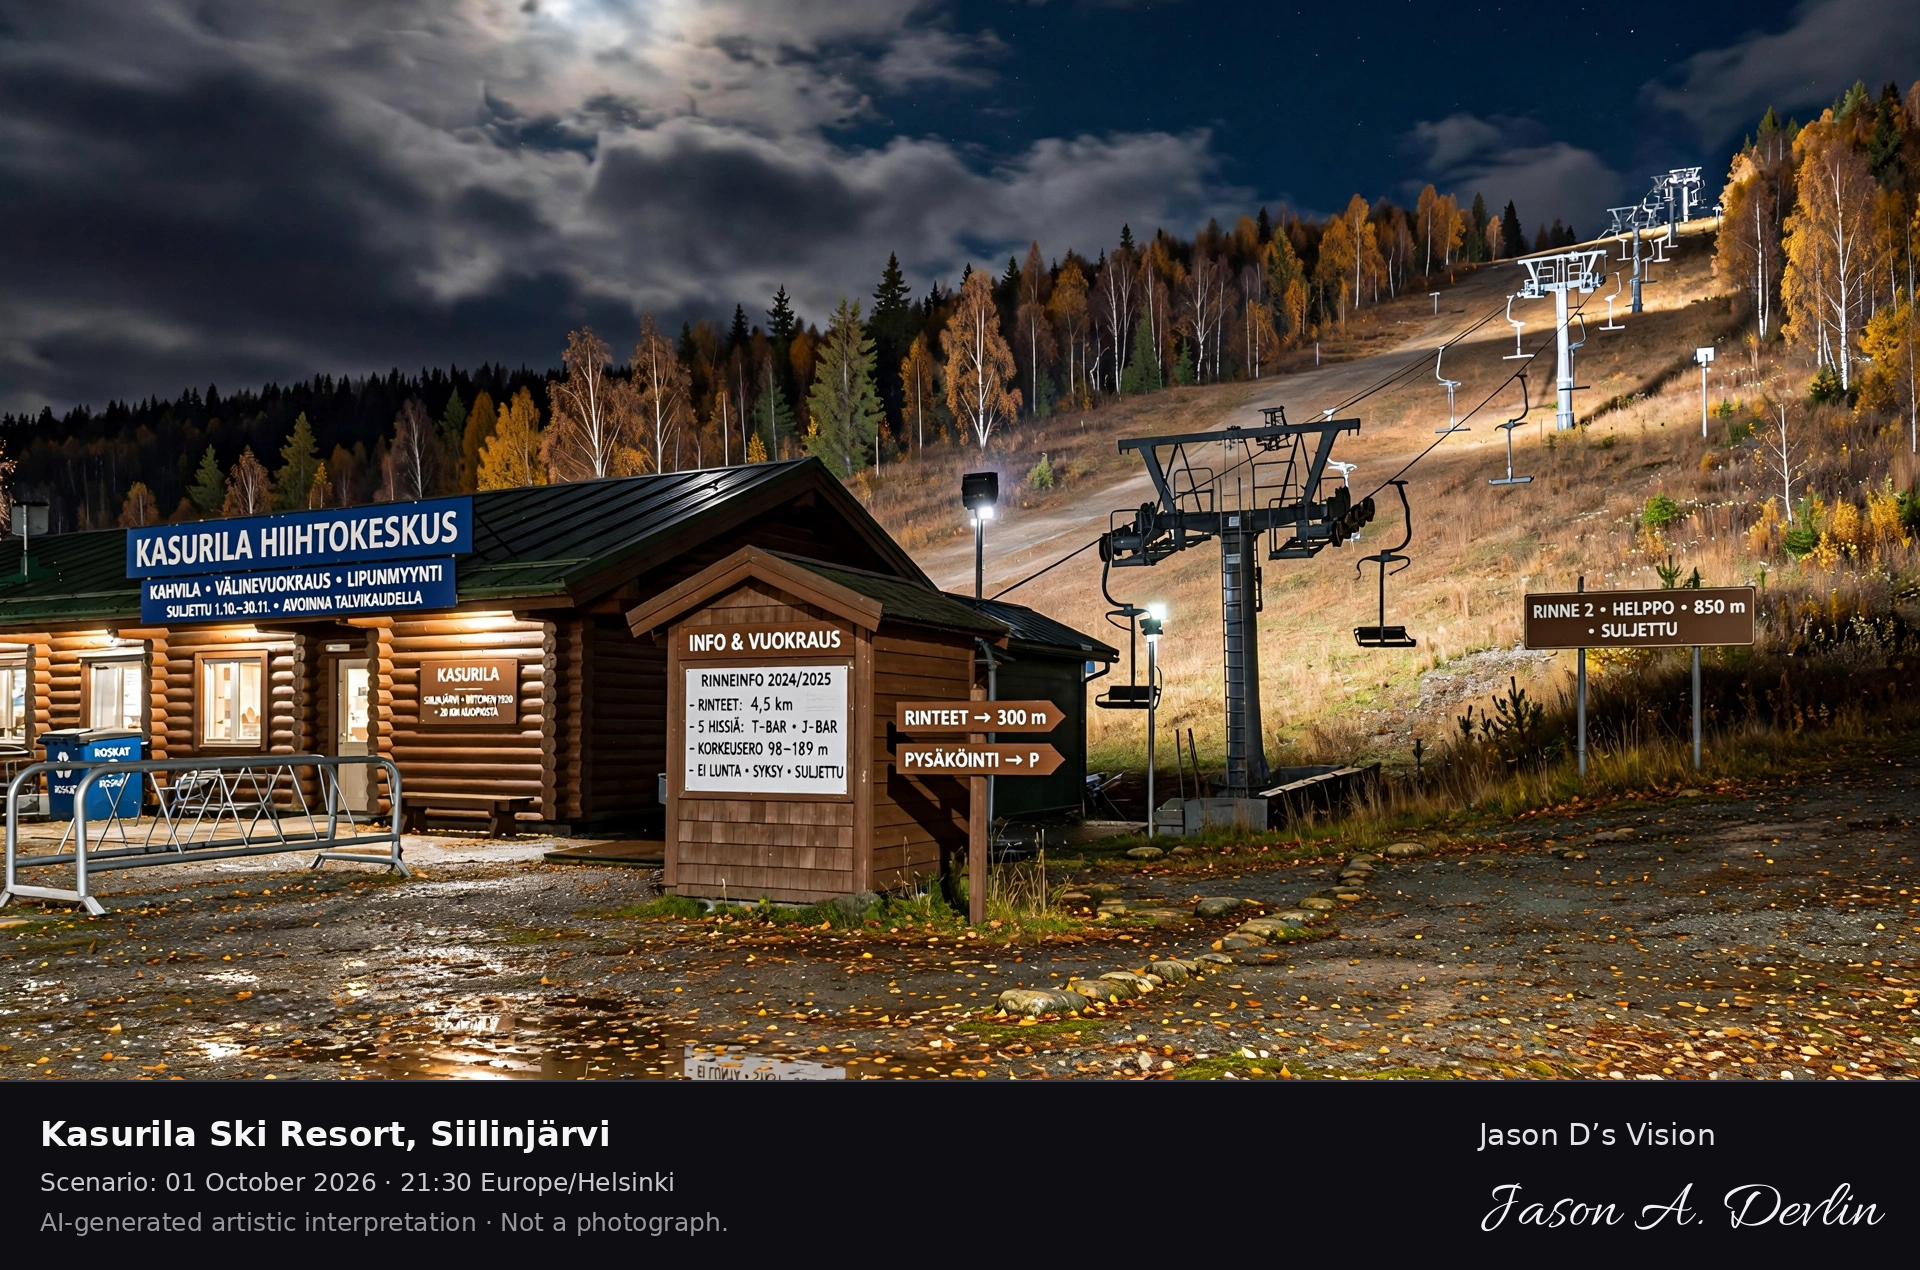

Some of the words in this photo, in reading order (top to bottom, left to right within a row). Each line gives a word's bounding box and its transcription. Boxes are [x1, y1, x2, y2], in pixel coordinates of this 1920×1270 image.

[136, 529, 253, 567] KASURILA
[260, 510, 458, 558] HIIHTOKESKUS
[149, 581, 201, 600] KAHVILA
[215, 571, 332, 597] VÄLINEVUOKRAUS
[347, 564, 442, 588] LIPUNMYYNTI
[166, 603, 213, 619] SULJETTU
[283, 597, 332, 613] AVOINNA
[335, 590, 423, 610] TALVIKAUDELLA
[1533, 603, 1580, 619] RINNE
[1584, 602, 1594, 618] 2
[1612, 600, 1675, 617] HELPPO
[1694, 599, 1725, 615] 850
[1729, 602, 1746, 614] m
[1601, 621, 1678, 638] SULJETTU
[689, 633, 727, 652] INFO
[731, 632, 744, 650] &
[749, 629, 841, 650] VUOKRAUS
[437, 667, 500, 682] KASURILA
[701, 672, 764, 688] RINNEINFO
[768, 671, 832, 688] 2024/2025
[697, 697, 743, 712] RINTEET:
[750, 697, 772, 714] 4,5
[775, 696, 793, 712] km
[698, 720, 705, 733] 5
[708, 716, 744, 734] HISSIÄ:
[752, 719, 787, 734] T-BAR
[801, 719, 838, 734] J-BAR
[905, 709, 969, 726] RINTEET
[997, 709, 1027, 726] 300
[1031, 712, 1047, 725] m
[94, 746, 131, 758] ROSKAT
[698, 741, 764, 756] KORKEUSERO
[817, 744, 828, 756] m
[904, 747, 1000, 768] PYSÄKÖINTI
[1029, 752, 1040, 768] P
[697, 763, 706, 777] EI
[709, 764, 742, 778] LUNTA
[752, 764, 784, 778] SYKSY
[795, 764, 844, 779] SULJETTU
